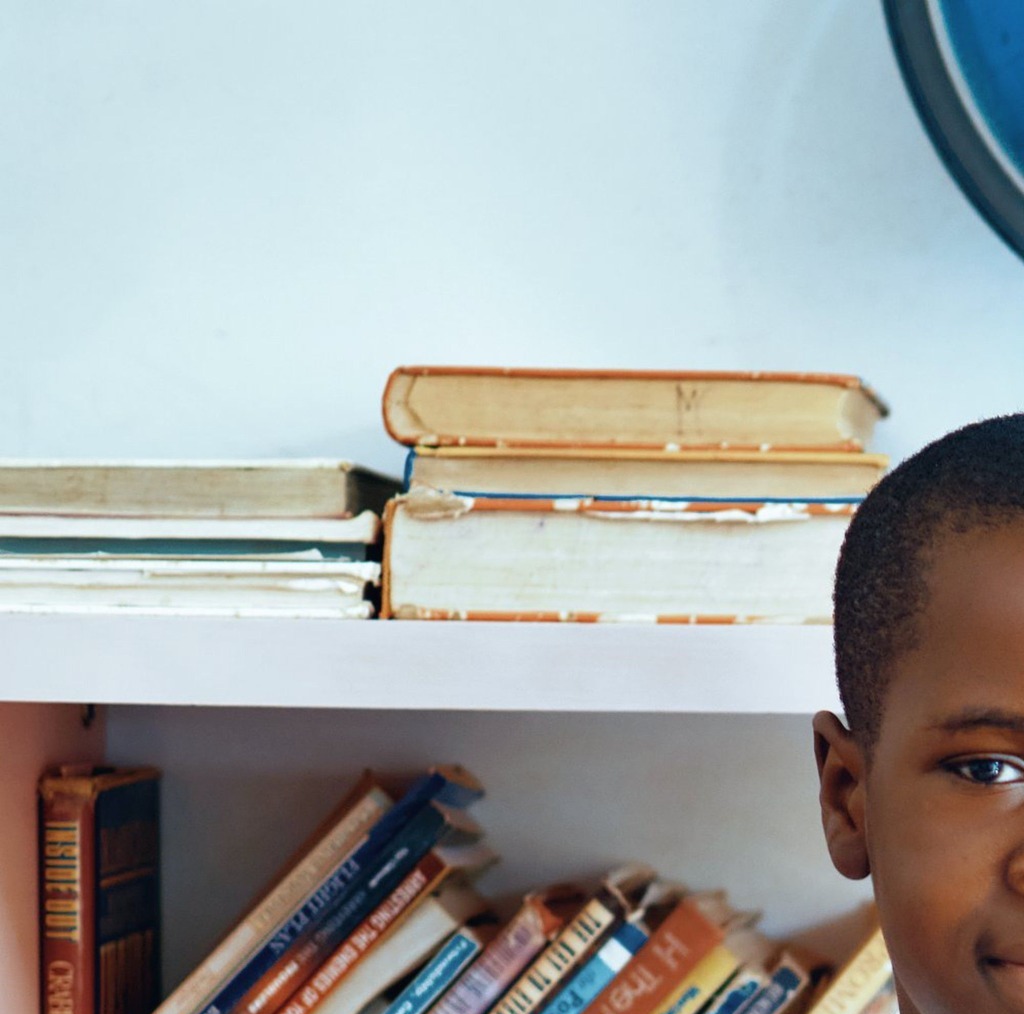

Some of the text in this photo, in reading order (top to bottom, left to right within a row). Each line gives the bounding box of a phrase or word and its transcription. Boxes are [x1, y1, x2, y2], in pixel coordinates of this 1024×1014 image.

[44, 819, 81, 941] INSIDE OUT
[266, 857, 362, 956] FLIGHT PLAN
[368, 868, 430, 931] ARRESTING
[350, 922, 379, 951] THE
[298, 985, 319, 1006] OF
[309, 942, 360, 993] ENEMIES
